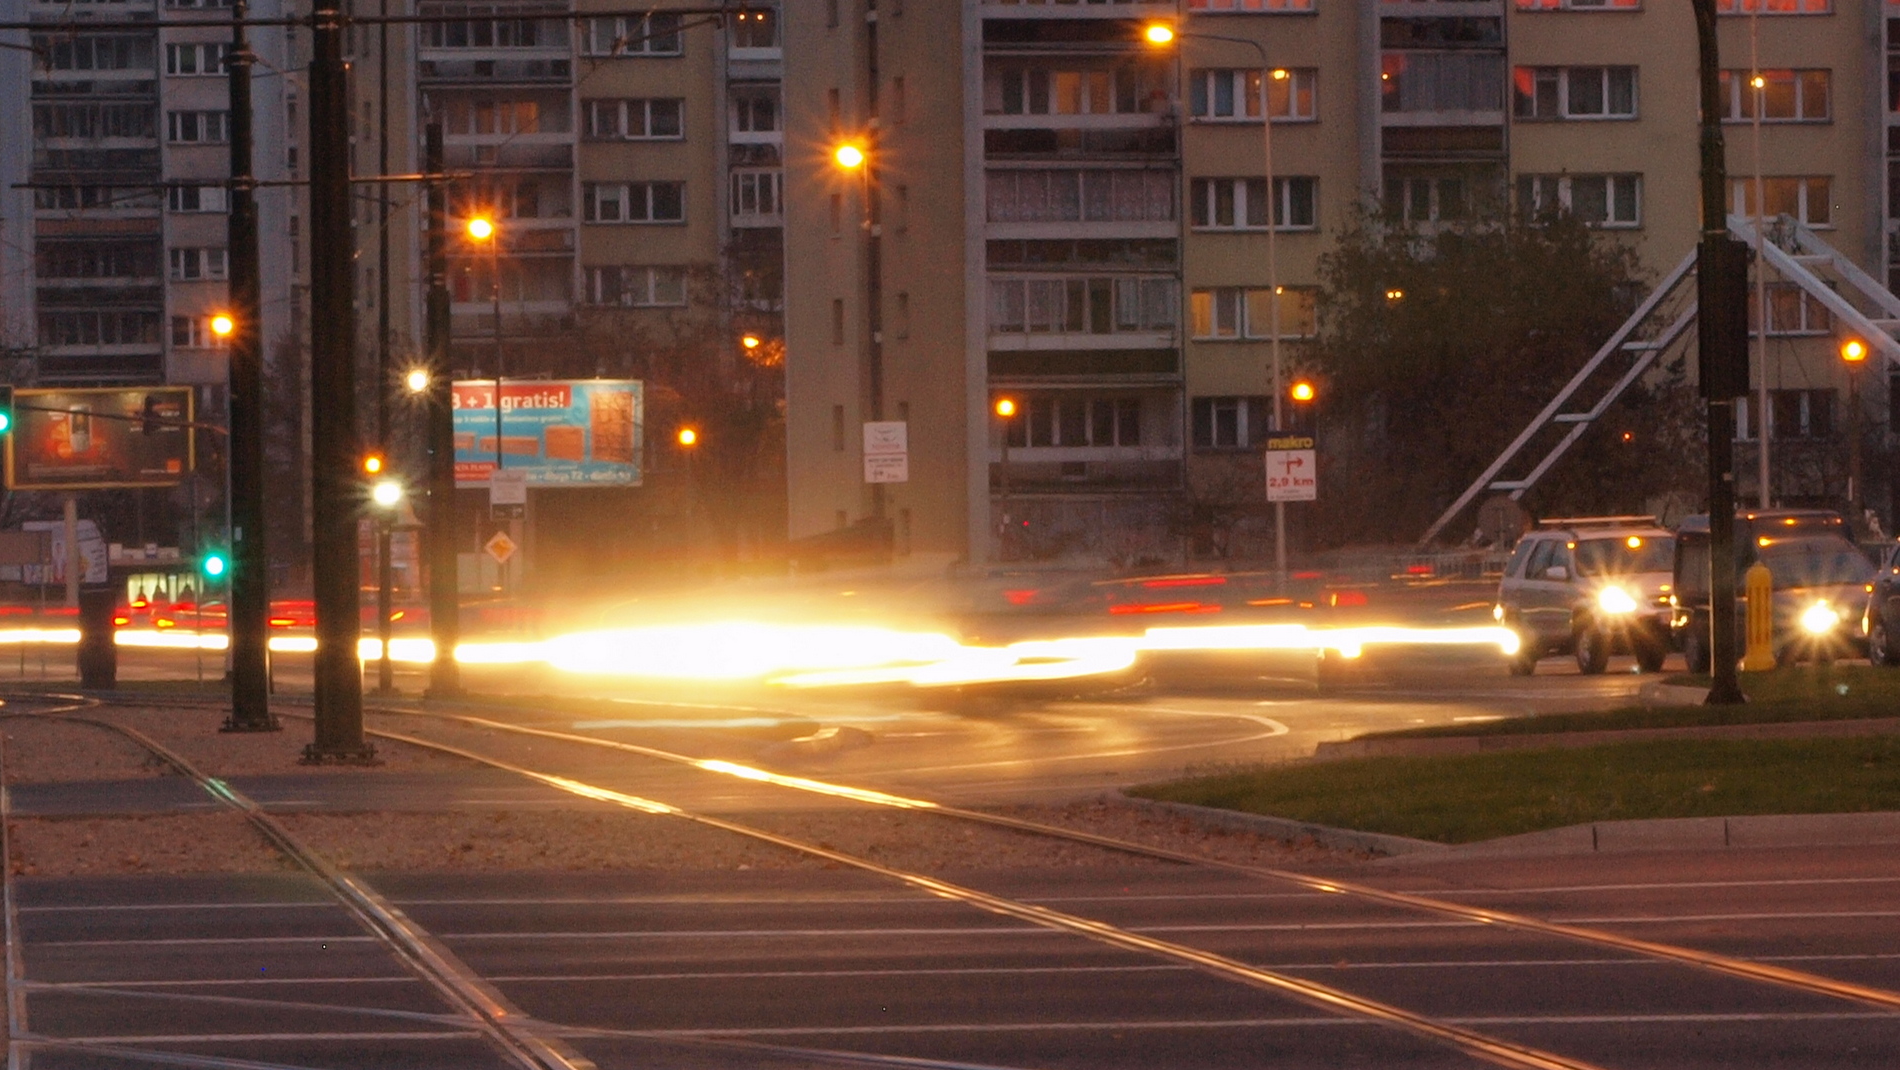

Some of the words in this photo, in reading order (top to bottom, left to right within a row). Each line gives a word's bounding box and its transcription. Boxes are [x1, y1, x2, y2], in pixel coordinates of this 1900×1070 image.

[466, 395, 478, 407] +
[483, 392, 495, 409] 1
[500, 391, 564, 413] gratis!
[1268, 435, 1314, 449] makro
[1293, 478, 1314, 486] km
